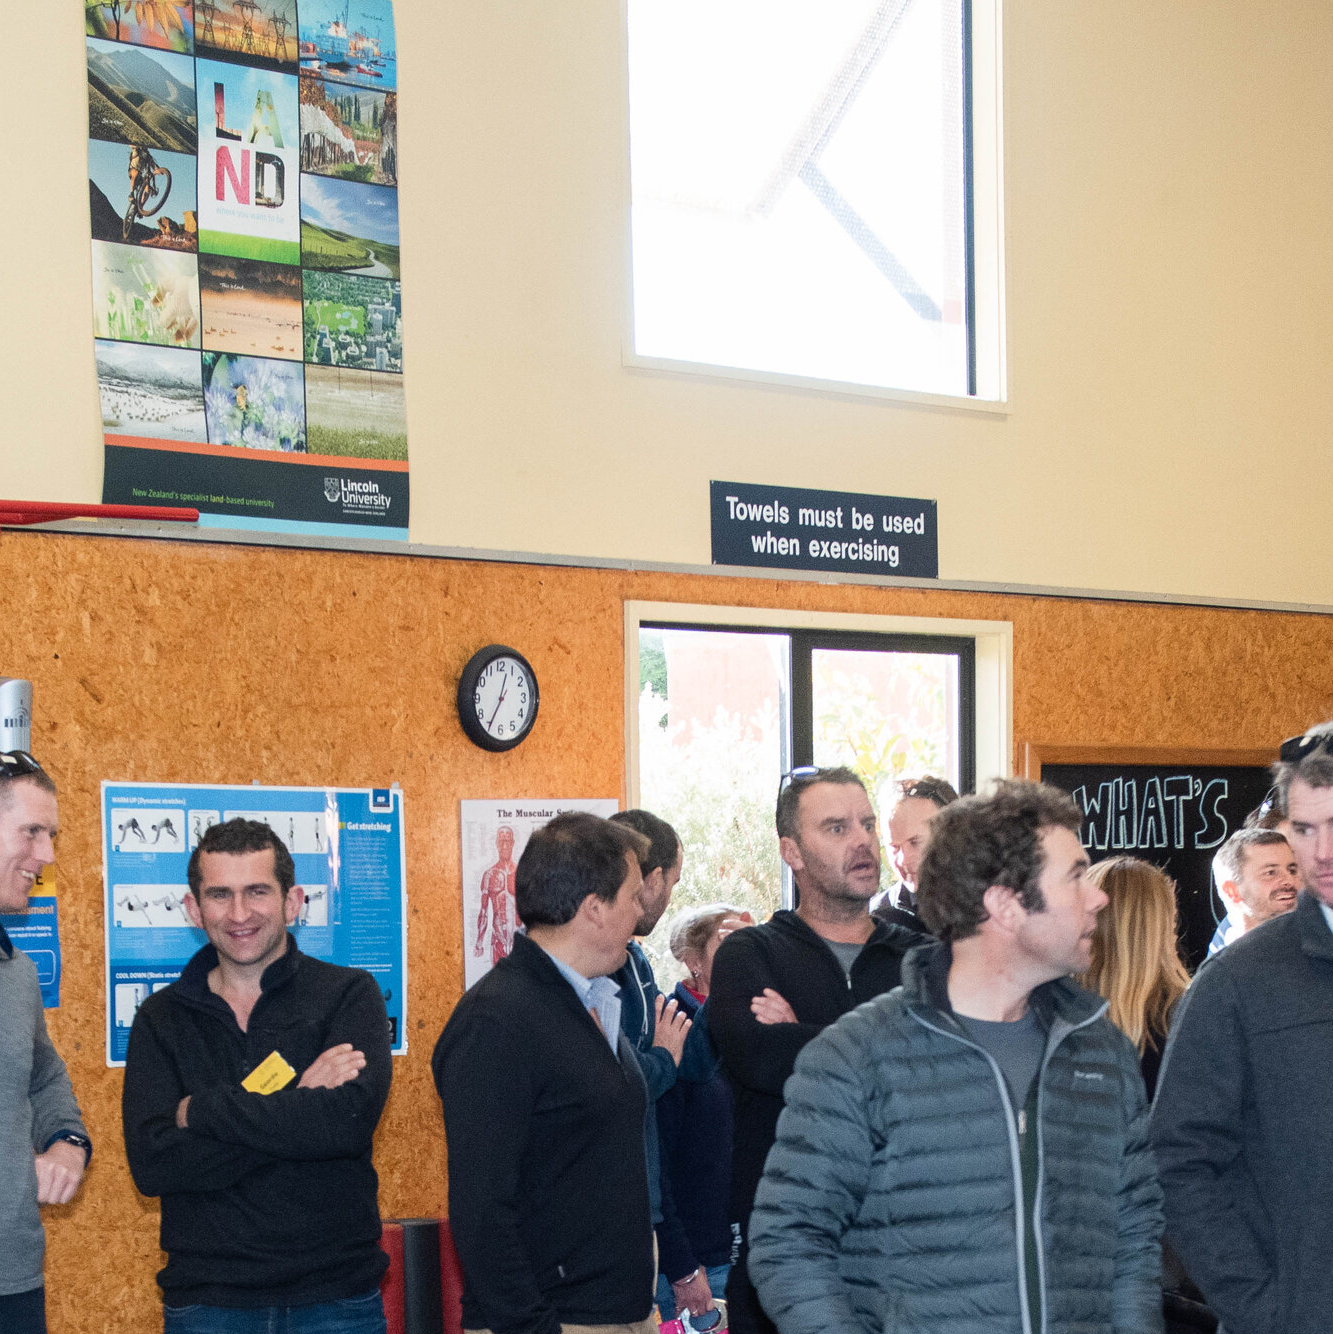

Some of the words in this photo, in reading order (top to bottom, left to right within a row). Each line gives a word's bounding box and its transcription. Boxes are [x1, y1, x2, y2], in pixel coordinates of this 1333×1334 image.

[340, 478, 379, 493] Lincoln
[132, 487, 147, 497] New
[148, 488, 179, 500] Zealand's
[180, 491, 209, 503] specialist
[245, 498, 275, 509] university
[341, 490, 392, 509] University
[725, 496, 789, 525] Towels
[798, 506, 843, 528] must
[851, 507, 874, 531] be
[882, 512, 925, 535] used
[751, 531, 800, 556] when
[808, 537, 900, 568] exercising
[496, 661, 506, 672] 12
[517, 676, 524, 687] 2
[520, 692, 527, 704] 3
[517, 708, 524, 719] 4
[497, 724, 504, 735] 6
[509, 720, 516, 732] 5
[497, 809, 513, 818] The
[516, 808, 553, 818] Muscular
[1073, 775, 1228, 850] WHAT'S
[359, 821, 392, 833] stretching
